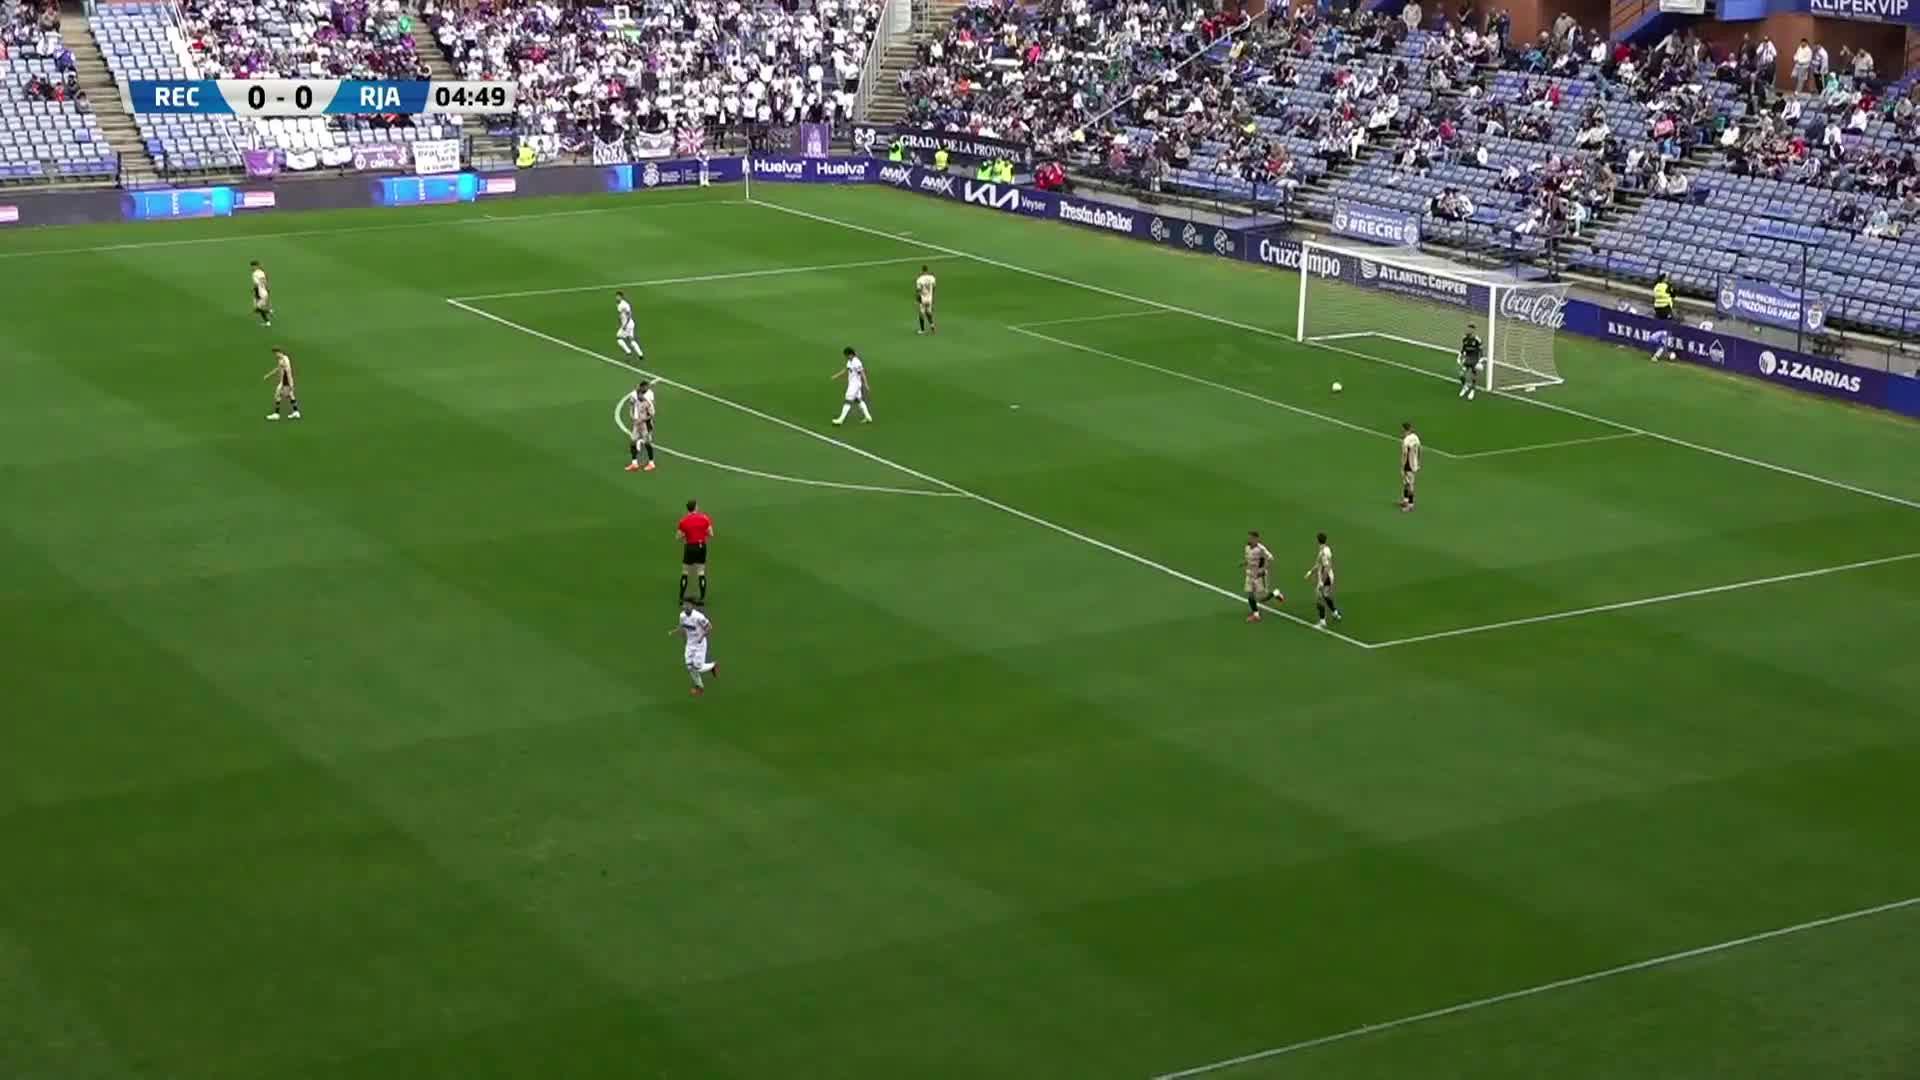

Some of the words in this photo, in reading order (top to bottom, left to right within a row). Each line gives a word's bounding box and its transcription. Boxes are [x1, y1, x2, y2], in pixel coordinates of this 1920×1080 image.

[901, 135, 941, 150] GRADA
[944, 138, 958, 152] DE
[959, 141, 973, 154] LA
[754, 159, 803, 174] Huelva
[817, 161, 865, 175] Huelva
[964, 180, 1020, 210] KIA
[1021, 195, 1047, 212] Veyser
[1094, 208, 1107, 227] de
[1106, 209, 1133, 233] Palos
[1350, 218, 1403, 241] #RECRE
[1260, 239, 1341, 278] Cruzcmpo
[1379, 264, 1428, 287] ATLANTIC
[1428, 275, 1468, 296] COPPER
